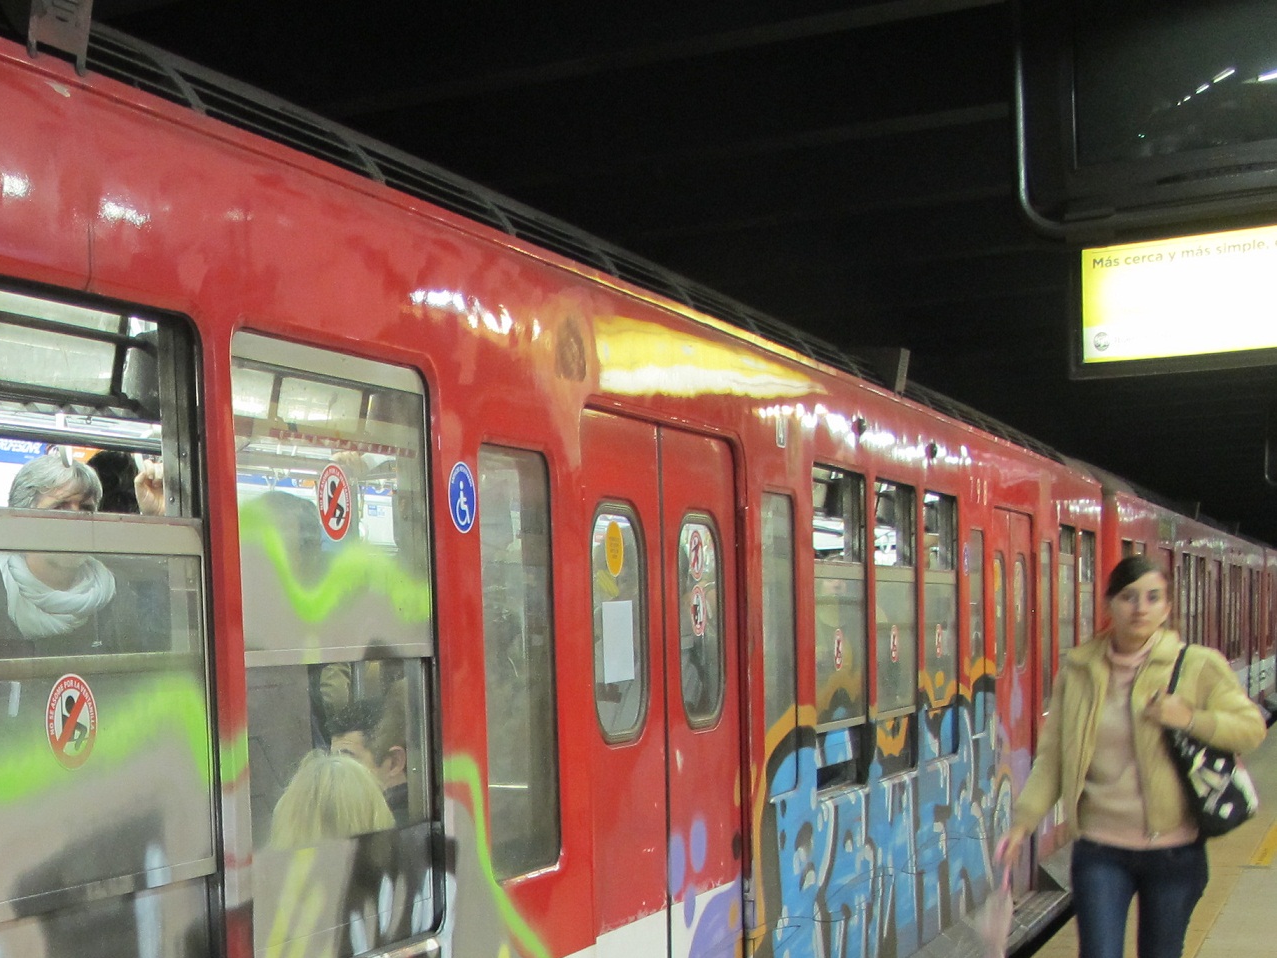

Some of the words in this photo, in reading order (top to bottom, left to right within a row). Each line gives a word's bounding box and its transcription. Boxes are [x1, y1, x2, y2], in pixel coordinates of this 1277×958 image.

[1092, 256, 1120, 269] Más
[1124, 253, 1163, 265] cerca
[1168, 251, 1176, 262] y
[1181, 246, 1211, 259] más
